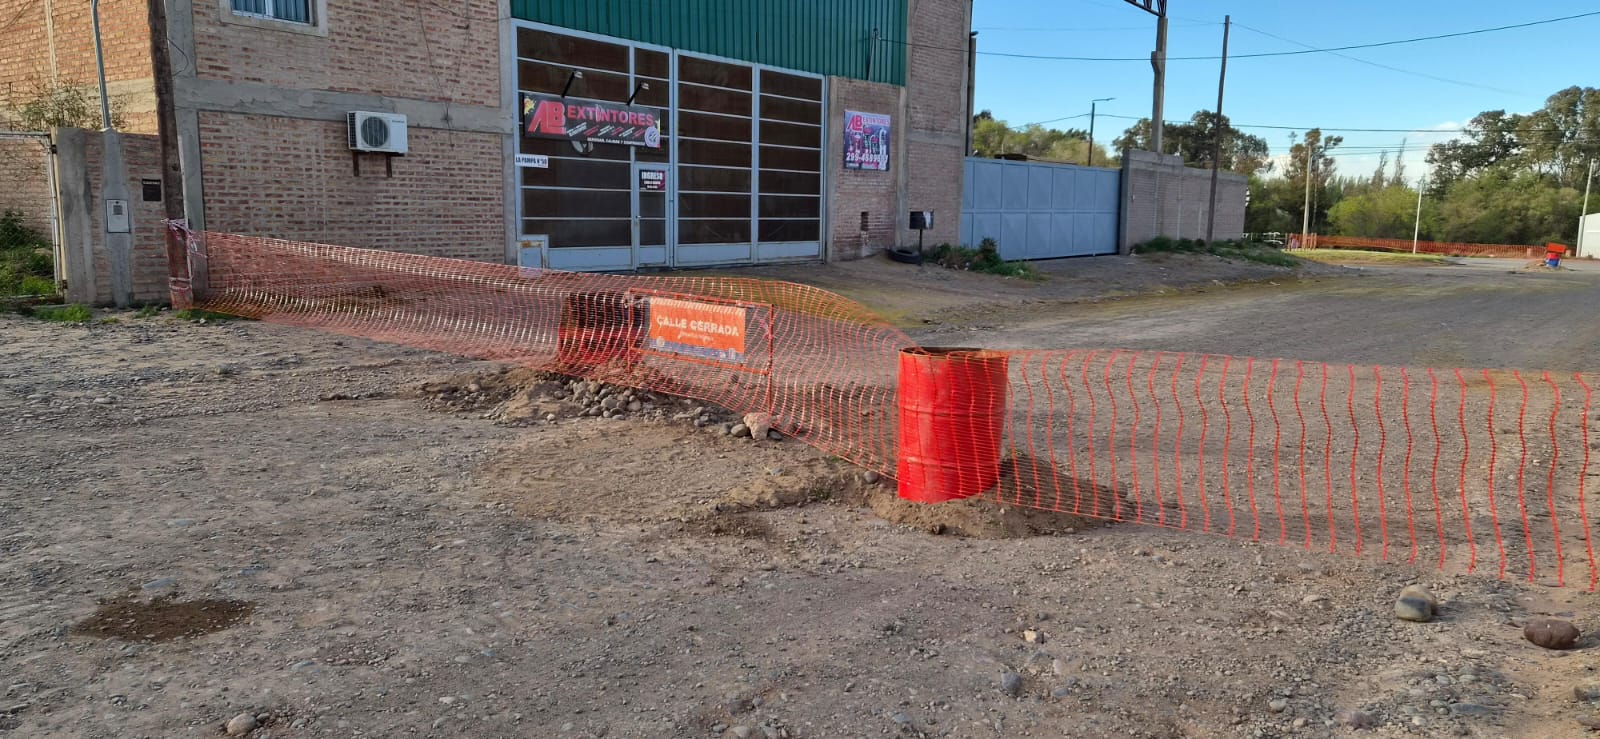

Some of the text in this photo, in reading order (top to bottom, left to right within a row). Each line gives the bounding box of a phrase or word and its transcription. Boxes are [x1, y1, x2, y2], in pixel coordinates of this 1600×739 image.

[528, 100, 566, 134] AB
[567, 104, 654, 125] EXTINTORES
[656, 314, 687, 328] CALLE
[690, 320, 739, 337] CERRADA
